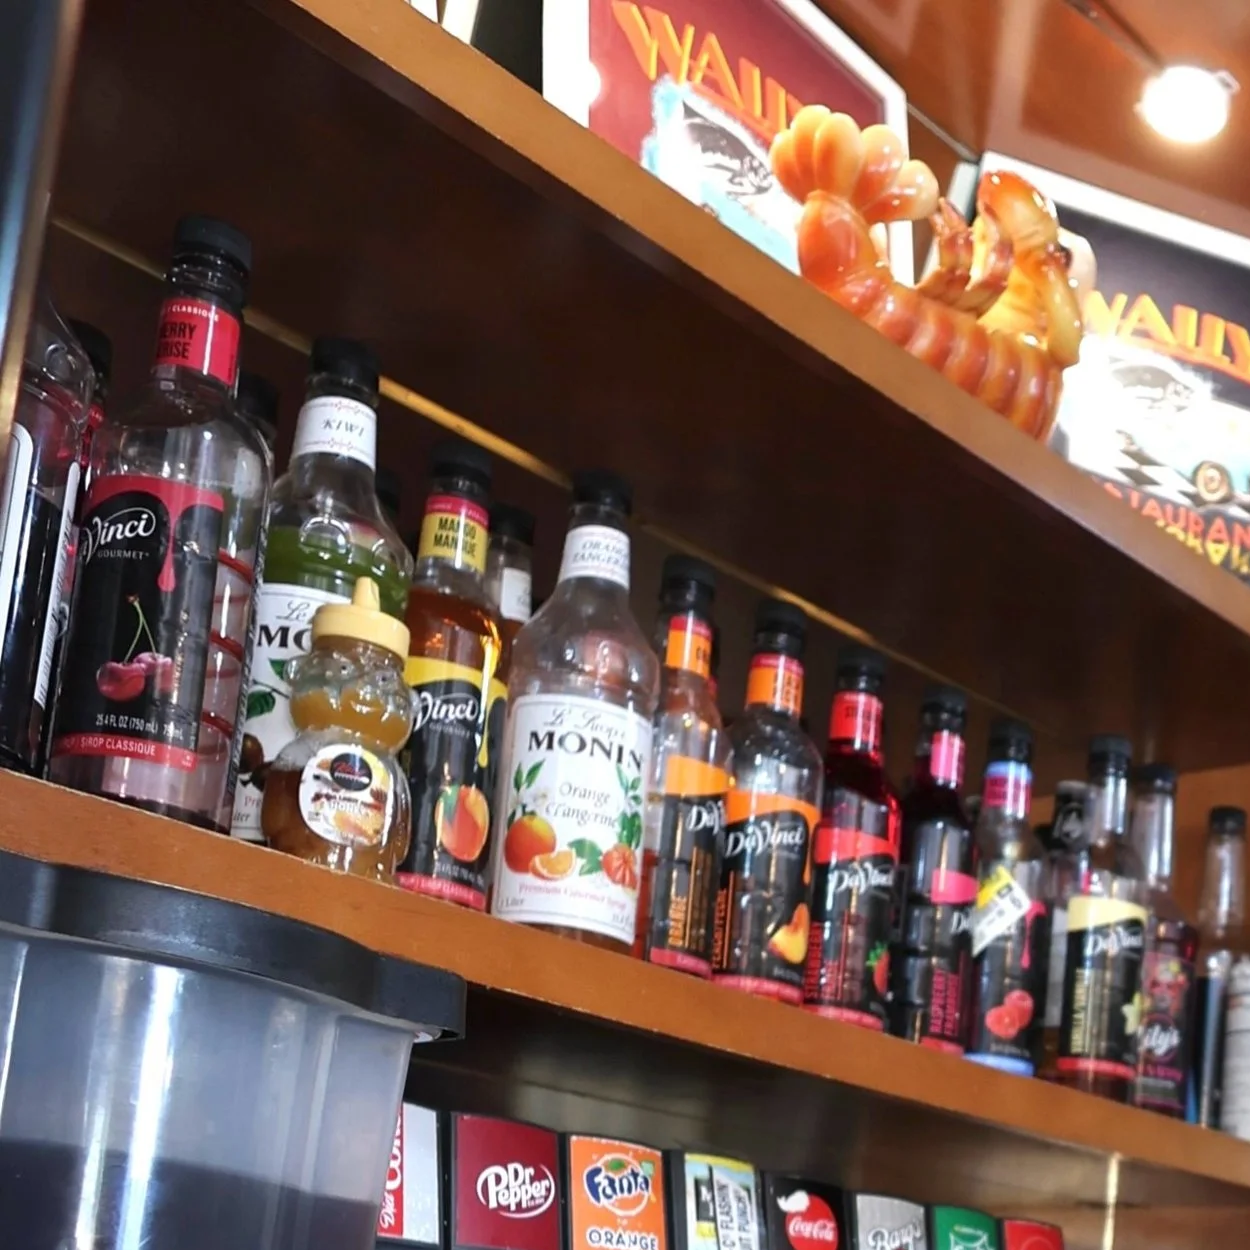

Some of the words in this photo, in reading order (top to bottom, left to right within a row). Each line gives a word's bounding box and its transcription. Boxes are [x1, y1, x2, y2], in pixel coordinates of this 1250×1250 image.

[528, 730, 643, 774] MONIN
[559, 782, 610, 808] Orange
[725, 820, 805, 858] DaVinci
[804, 921, 824, 999] STRAWBERRY
[477, 1166, 550, 1211] Pepper
[507, 1163, 535, 1188] Dr
[584, 1162, 651, 1207] Fanta
